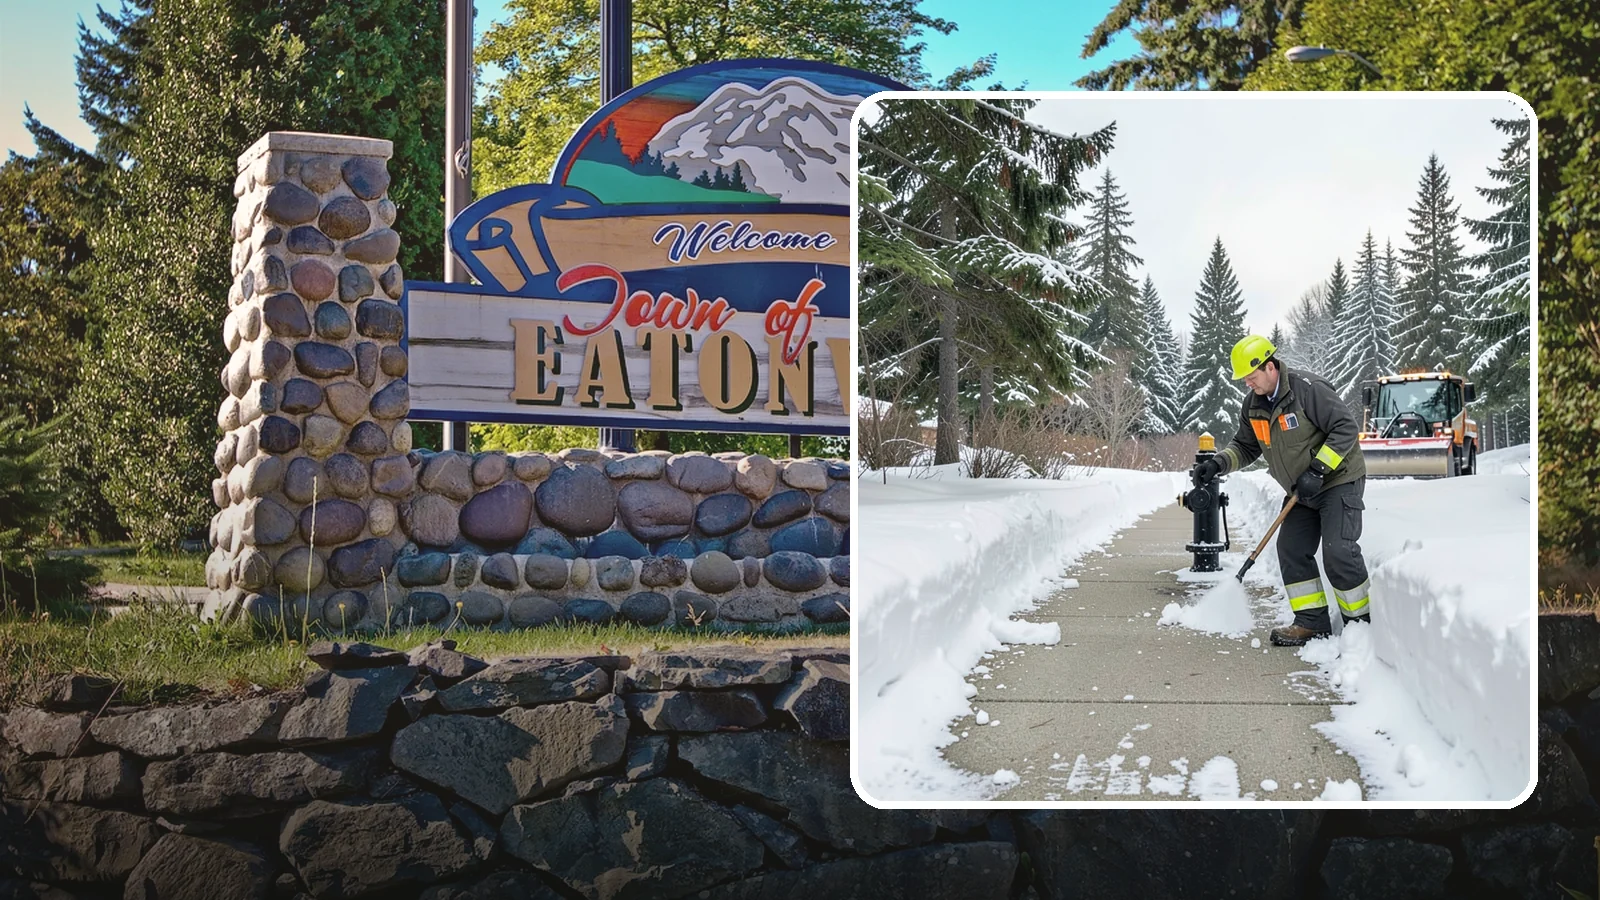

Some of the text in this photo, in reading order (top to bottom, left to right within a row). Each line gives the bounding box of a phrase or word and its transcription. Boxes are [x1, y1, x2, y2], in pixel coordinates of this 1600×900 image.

[653, 221, 837, 263] Welcome
[557, 264, 825, 364] Town of
